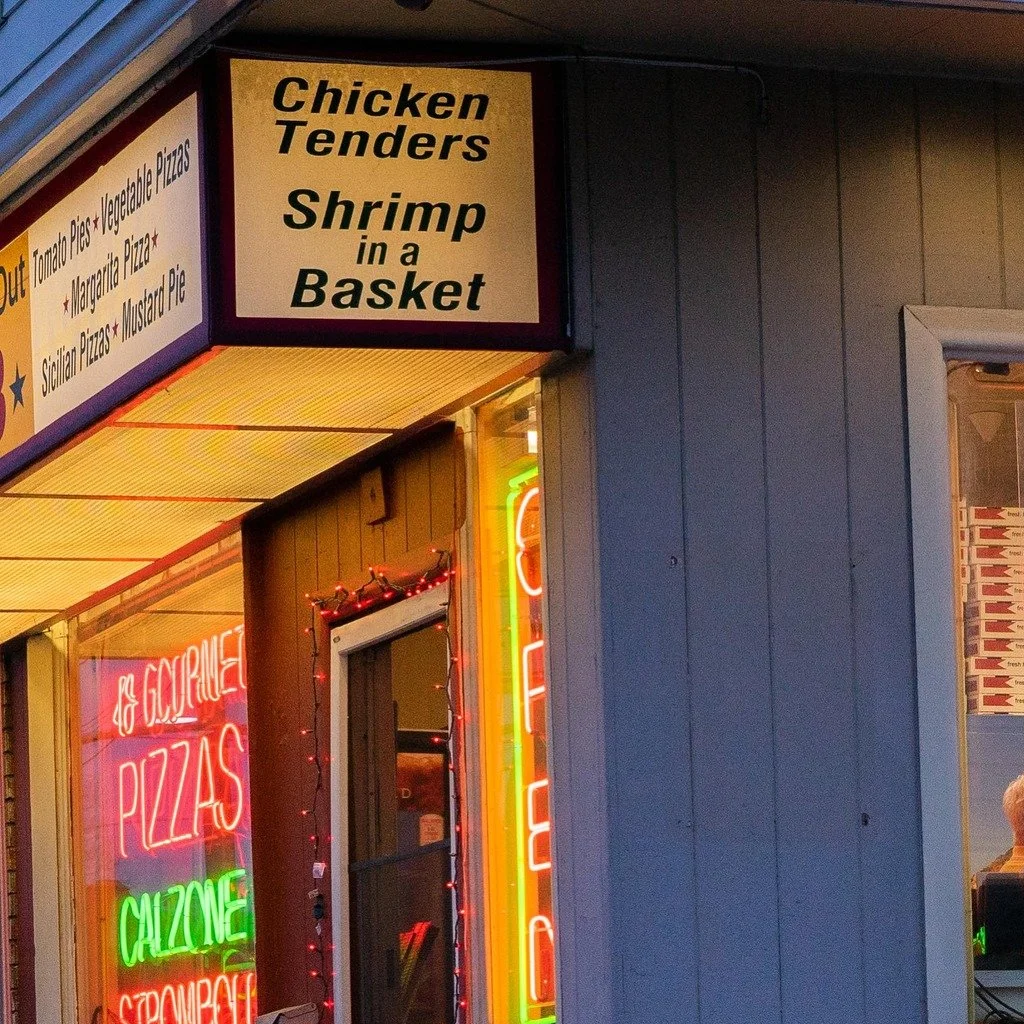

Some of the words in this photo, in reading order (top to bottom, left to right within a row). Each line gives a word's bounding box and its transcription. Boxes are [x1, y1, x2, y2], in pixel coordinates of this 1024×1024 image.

[272, 76, 490, 120] Chicken
[275, 119, 491, 162] Tenders
[33, 232, 68, 288] Tomato
[70, 215, 91, 260] Pies
[101, 163, 152, 235] Vegetable
[155, 138, 190, 195] Pizzas
[283, 188, 487, 242] Shrimp
[71, 251, 119, 319] Margarita
[124, 232, 150, 280] Pizza
[356, 235, 388, 265] in
[399, 242, 420, 266] a
[290, 268, 486, 311] Basket
[42, 344, 76, 398] Sicilian
[80, 323, 110, 371] Pizzas
[121, 274, 165, 342] Mustard
[168, 264, 186, 311] Pie
[119, 722, 244, 858] PIZZAS
[119, 868, 247, 968] CALZONE
